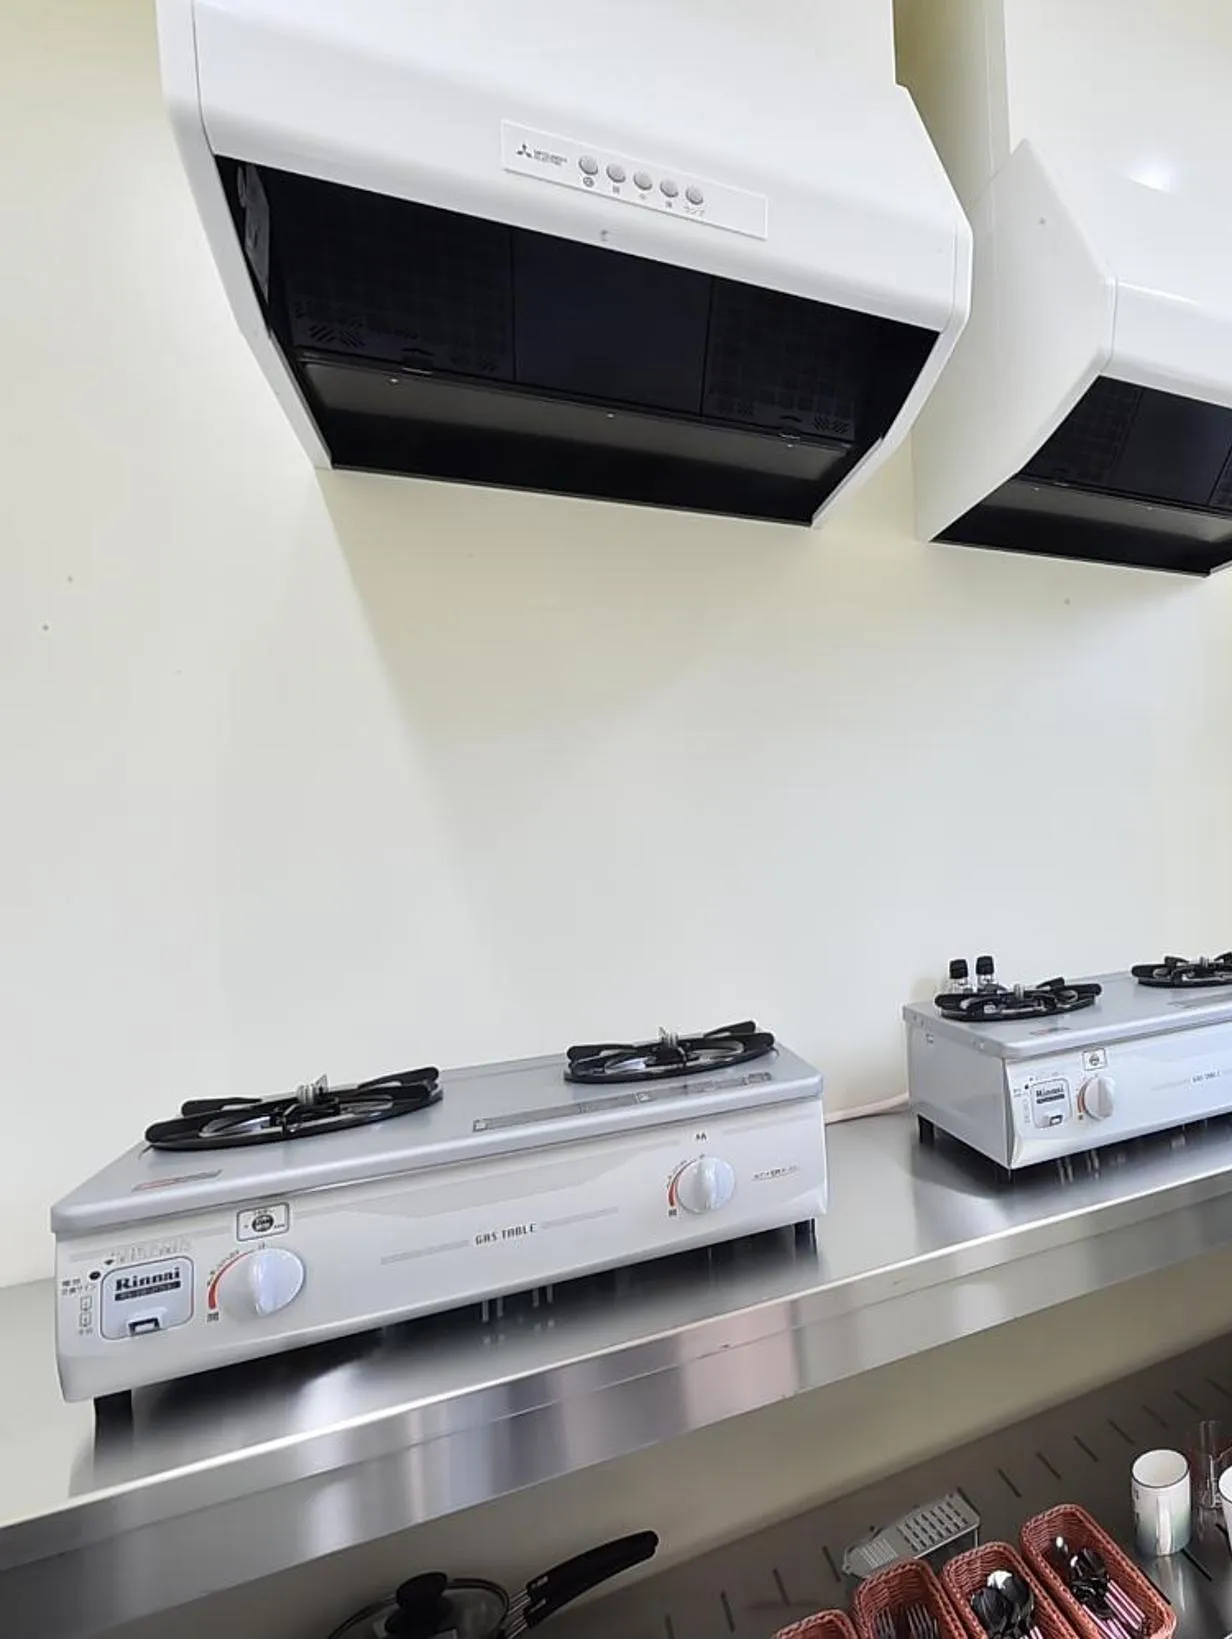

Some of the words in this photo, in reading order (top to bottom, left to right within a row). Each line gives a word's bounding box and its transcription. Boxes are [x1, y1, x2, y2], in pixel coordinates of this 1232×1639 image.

[475, 1232, 498, 1245] GAS
[501, 1223, 537, 1239] TABLE
[115, 1267, 180, 1291] Rinnai
